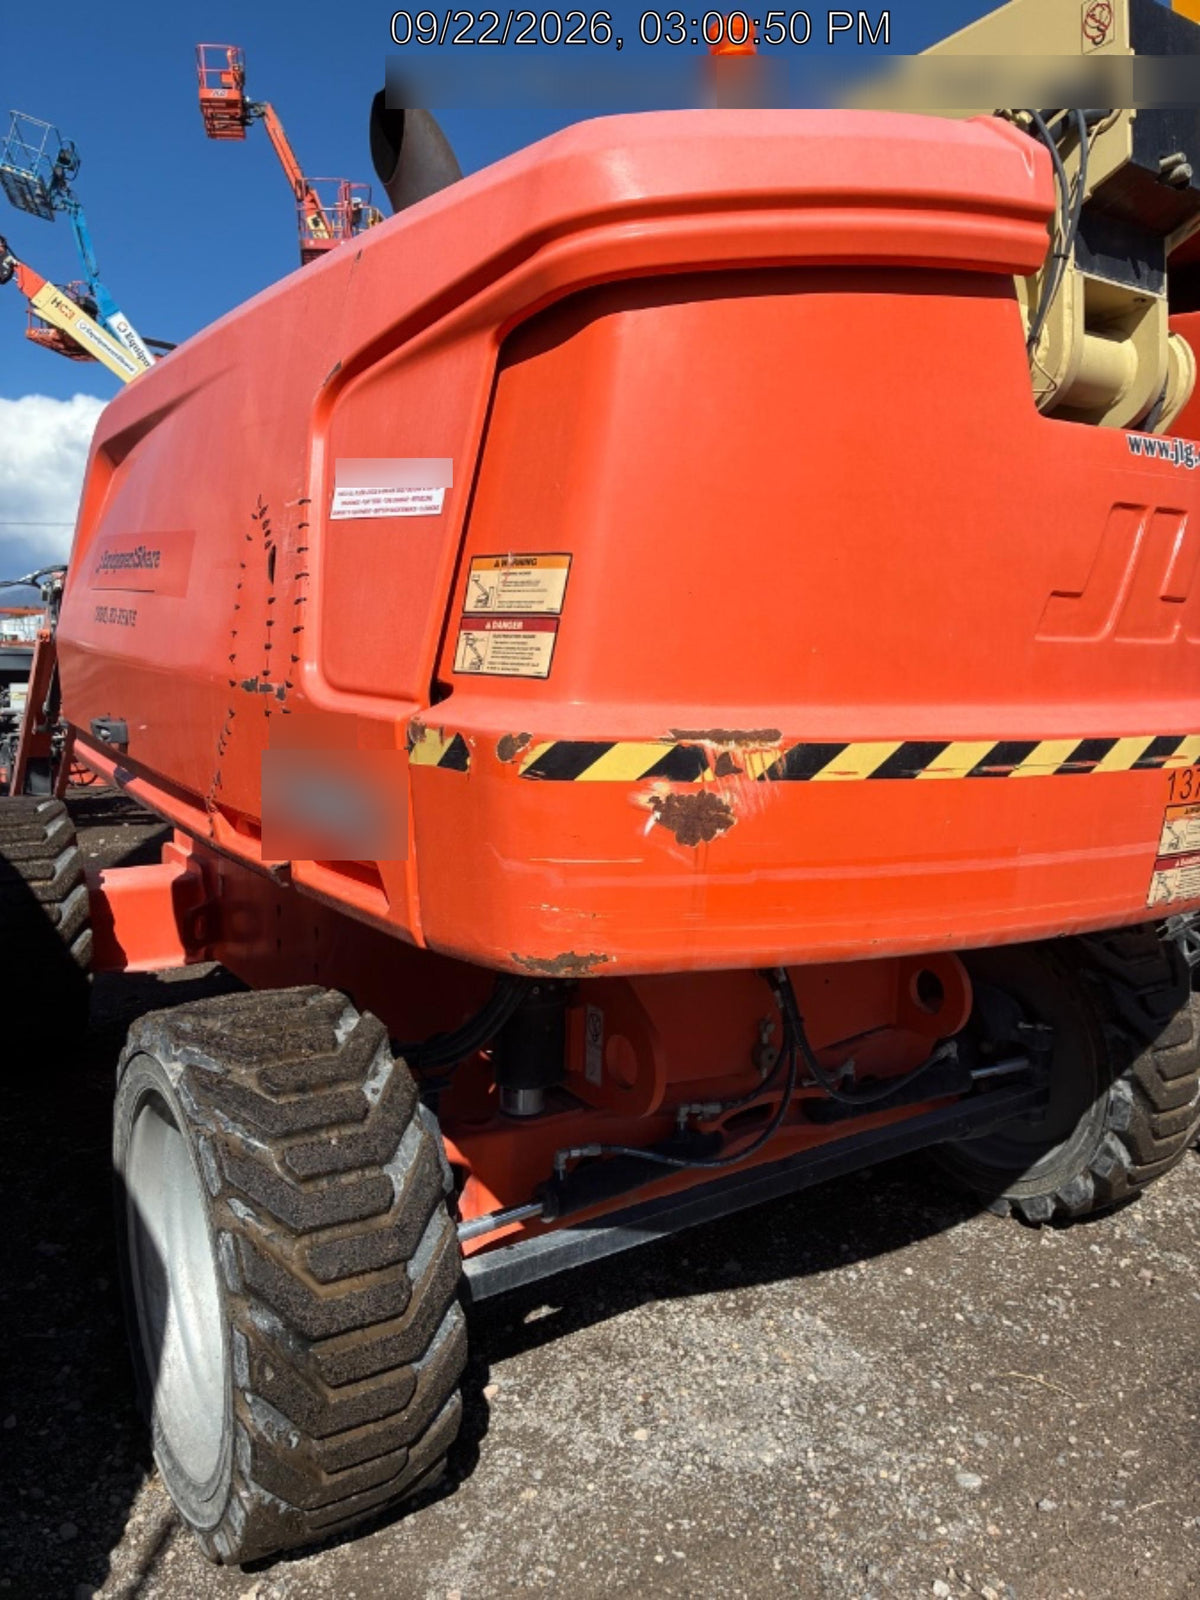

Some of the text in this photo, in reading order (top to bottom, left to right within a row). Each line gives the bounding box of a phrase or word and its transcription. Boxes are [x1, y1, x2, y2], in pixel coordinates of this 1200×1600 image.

[1127, 434, 1200, 468] www.jlg.
[501, 557, 538, 567] WRNING
[1034, 501, 1200, 644] JL
[492, 620, 524, 630] DANGER
